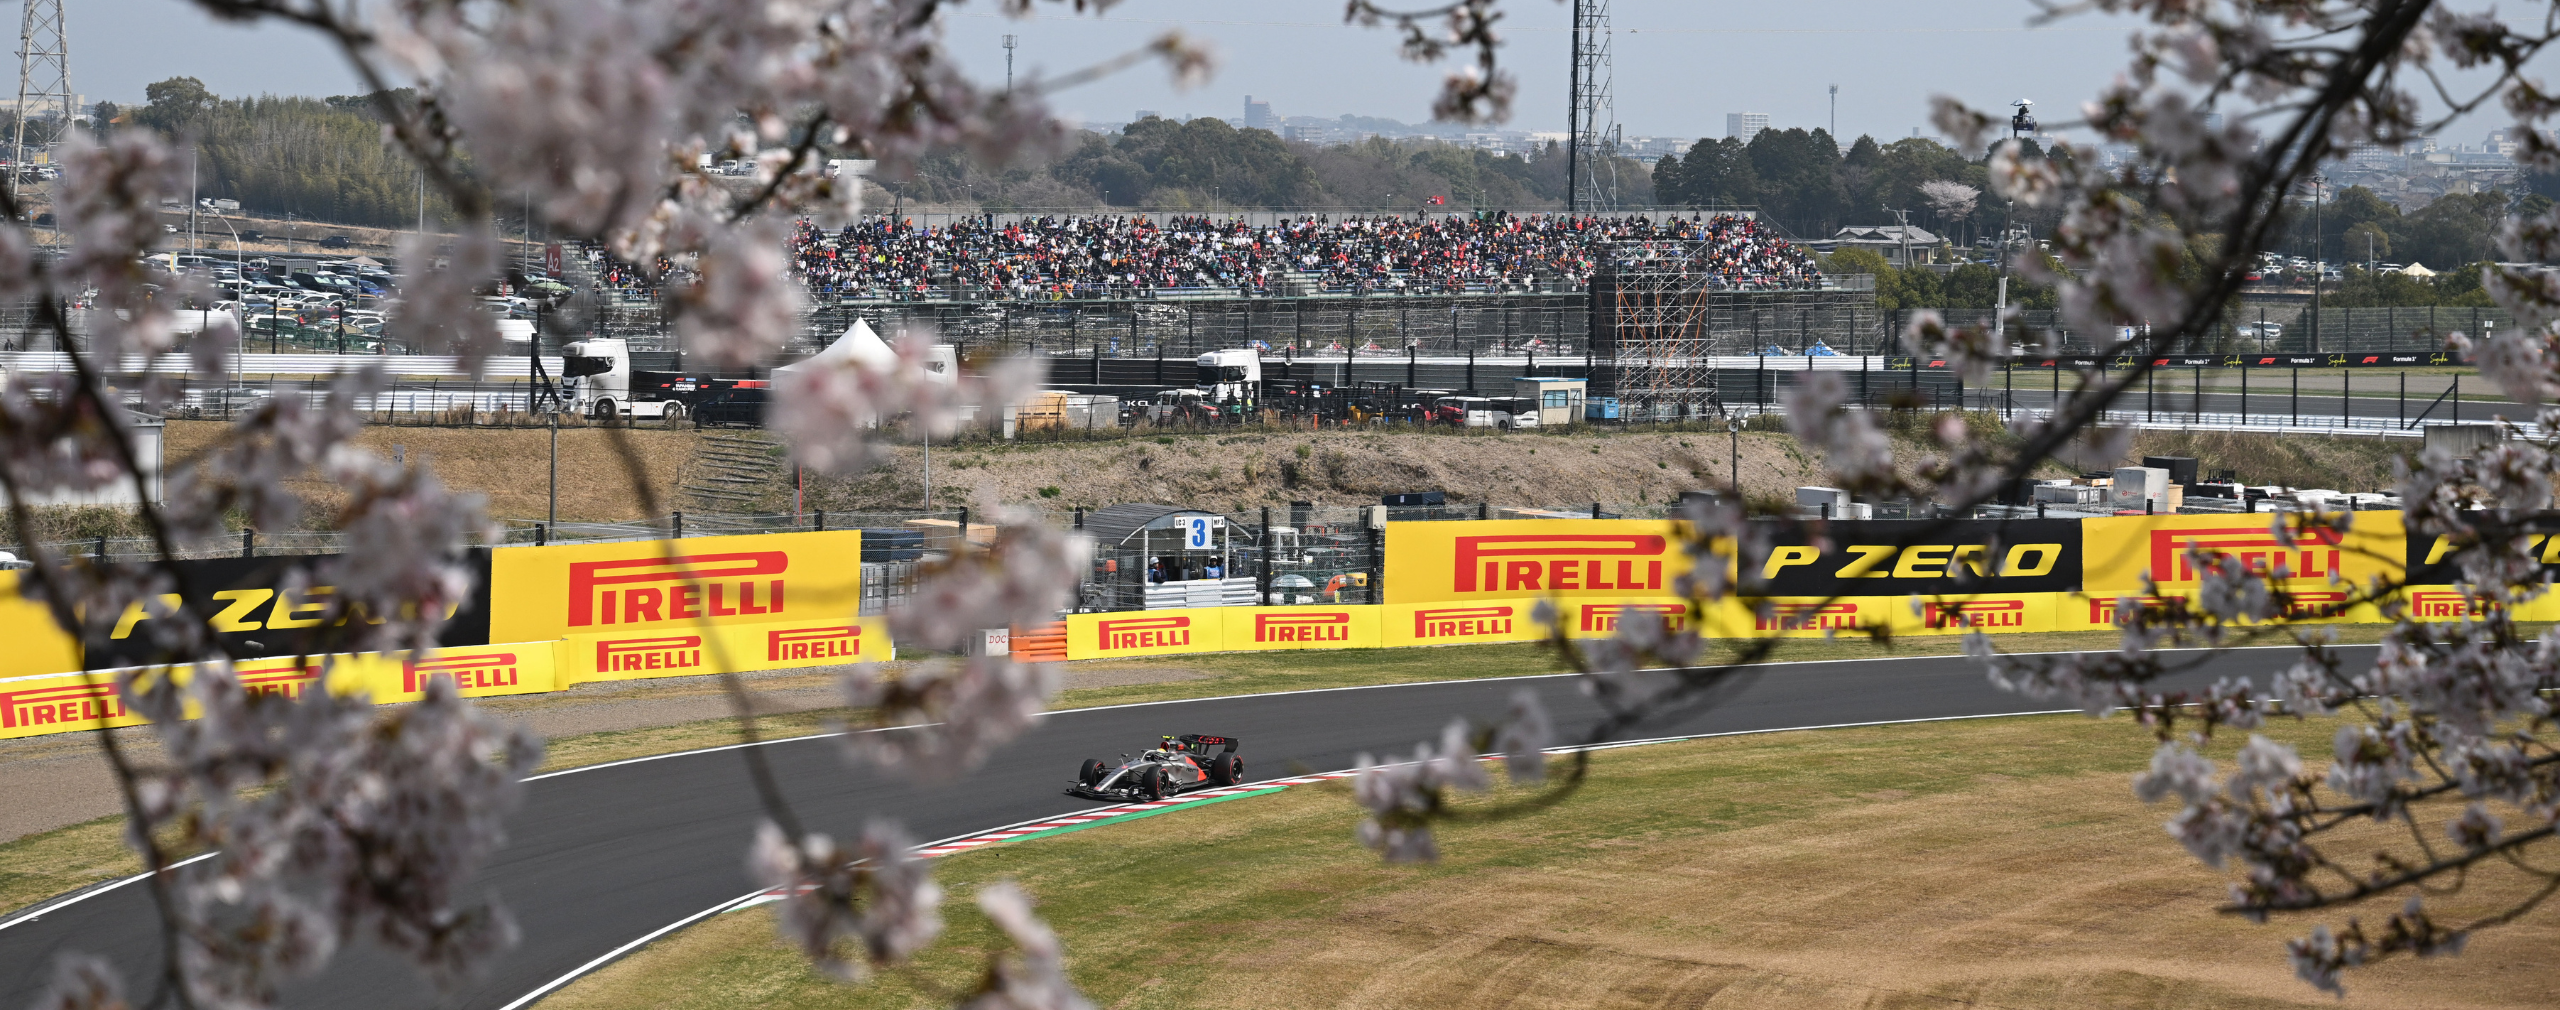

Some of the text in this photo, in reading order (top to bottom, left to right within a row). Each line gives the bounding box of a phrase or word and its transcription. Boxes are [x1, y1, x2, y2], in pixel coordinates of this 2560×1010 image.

[548, 252, 560, 272] A2
[1192, 519, 1206, 547] 3
[1454, 534, 1667, 593] PIRELLI
[1760, 543, 2063, 580] P ZERO
[568, 551, 788, 627] PIRELLI
[1099, 616, 1190, 650] PIRELLI
[1255, 612, 1350, 642] PIRELLI
[1414, 606, 1513, 638] PIRELLI
[1580, 604, 1687, 631] PIRLI
[596, 635, 702, 672] PIRELLI
[767, 625, 861, 661] PIRELLI
[988, 635, 1007, 644] DOC
[402, 652, 518, 693] PIELLI
[0, 682, 126, 728] PIRELLI
